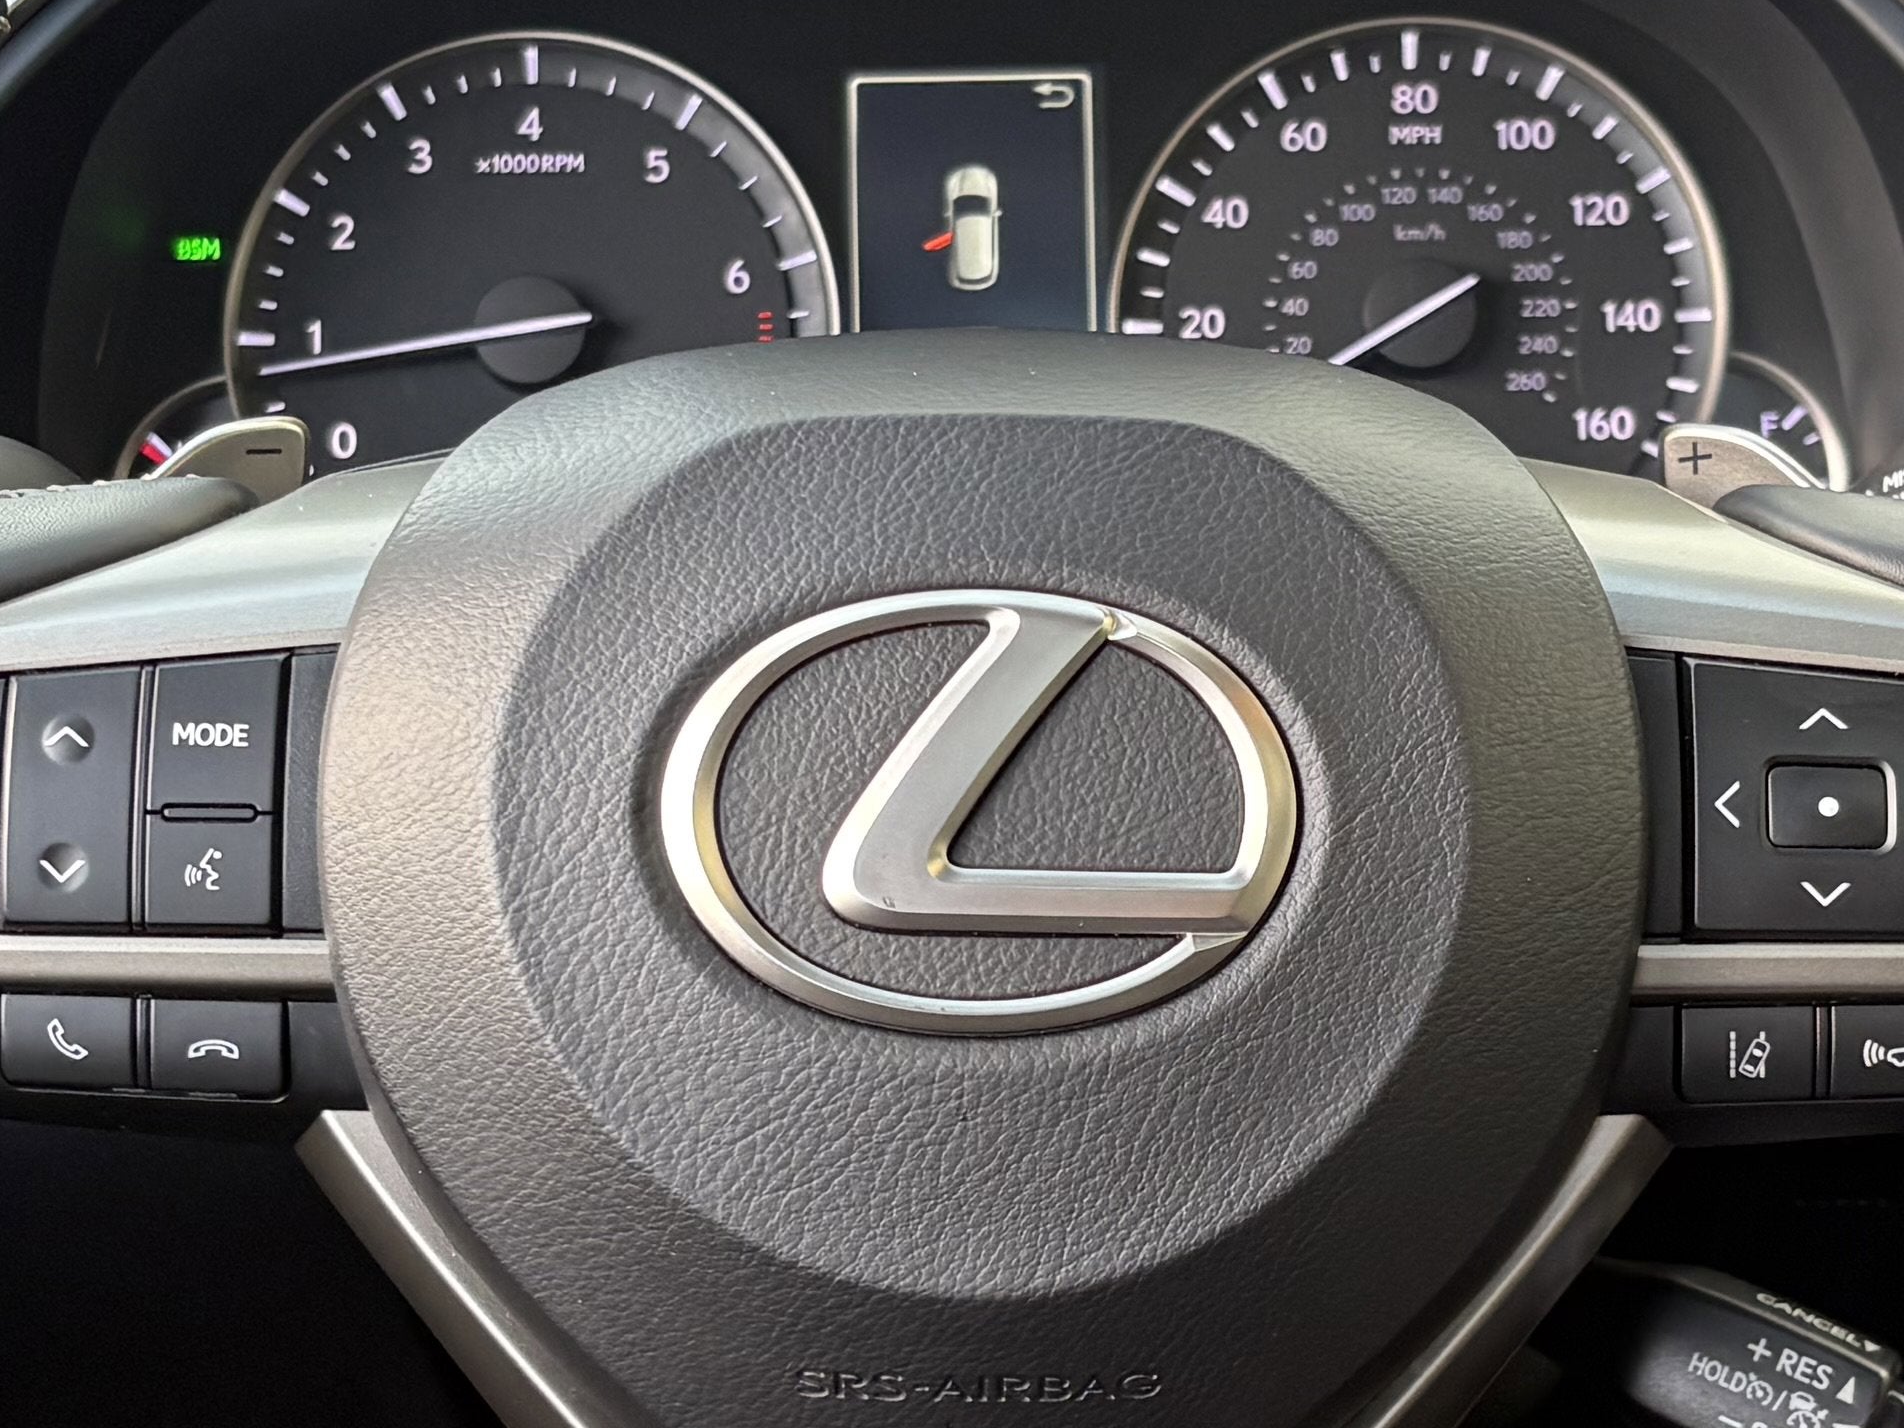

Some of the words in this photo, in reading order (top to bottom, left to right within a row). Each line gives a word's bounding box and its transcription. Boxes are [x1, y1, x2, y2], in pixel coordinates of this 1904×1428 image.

[1390, 84, 1439, 115] 80
[517, 107, 543, 142] 4
[1279, 121, 1327, 153] 60
[1388, 123, 1442, 147] MPH
[1495, 119, 1555, 151] 100
[407, 139, 433, 175] 3
[644, 149, 671, 184] 5
[1380, 185, 1417, 205] 120
[1427, 185, 1463, 205] 140
[1202, 196, 1249, 230] 40
[1339, 202, 1375, 222] 100
[1467, 202, 1504, 222] 160
[1571, 195, 1630, 228] 120
[330, 215, 356, 251] 2
[1310, 228, 1339, 248] 80
[1394, 222, 1446, 243] km/h
[1498, 228, 1533, 249] 180
[176, 236, 221, 261] BSM
[725, 260, 752, 295] 6
[1289, 260, 1317, 279] 60
[1512, 262, 1552, 282] 200
[1281, 297, 1310, 317] 40
[1521, 298, 1561, 318] 220
[1602, 300, 1662, 334] 140
[304, 321, 325, 354] 1
[1178, 307, 1226, 340] 20
[1285, 336, 1312, 355] 20
[1518, 334, 1559, 354] 240
[1506, 372, 1546, 392] 260
[1573, 407, 1635, 441] 160
[1760, 409, 1780, 438] F
[329, 422, 358, 460] 0
[172, 721, 250, 748] MODE
[1756, 1291, 1863, 1349] CANCEL
[796, 1370, 1163, 1403] SRS-AIRBAG
[1689, 1351, 1746, 1393] HOLD
